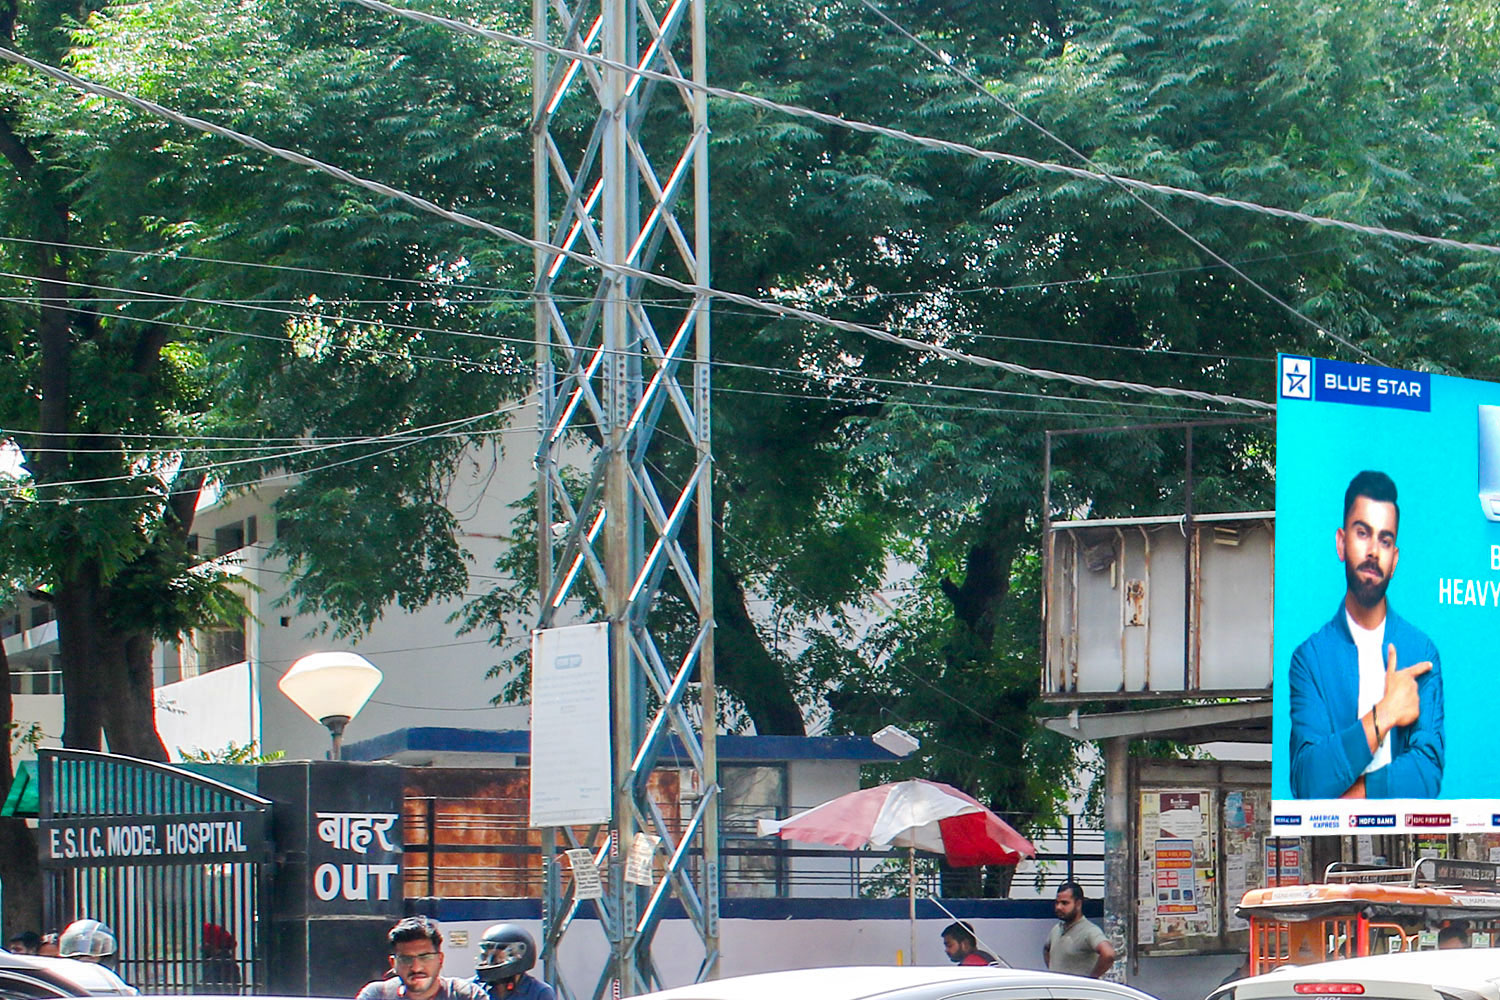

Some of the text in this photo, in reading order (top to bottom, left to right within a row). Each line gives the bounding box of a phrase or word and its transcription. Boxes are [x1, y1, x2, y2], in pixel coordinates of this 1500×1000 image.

[1324, 373, 1421, 397] BLUE STAR
[1439, 578, 1500, 607] HEAVY
[315, 812, 399, 854] बाहर
[1359, 817, 1394, 825] HDFC BANK
[51, 821, 247, 859] E.S.I.C. MODEL HOSPITAL
[314, 863, 399, 901] OUT
